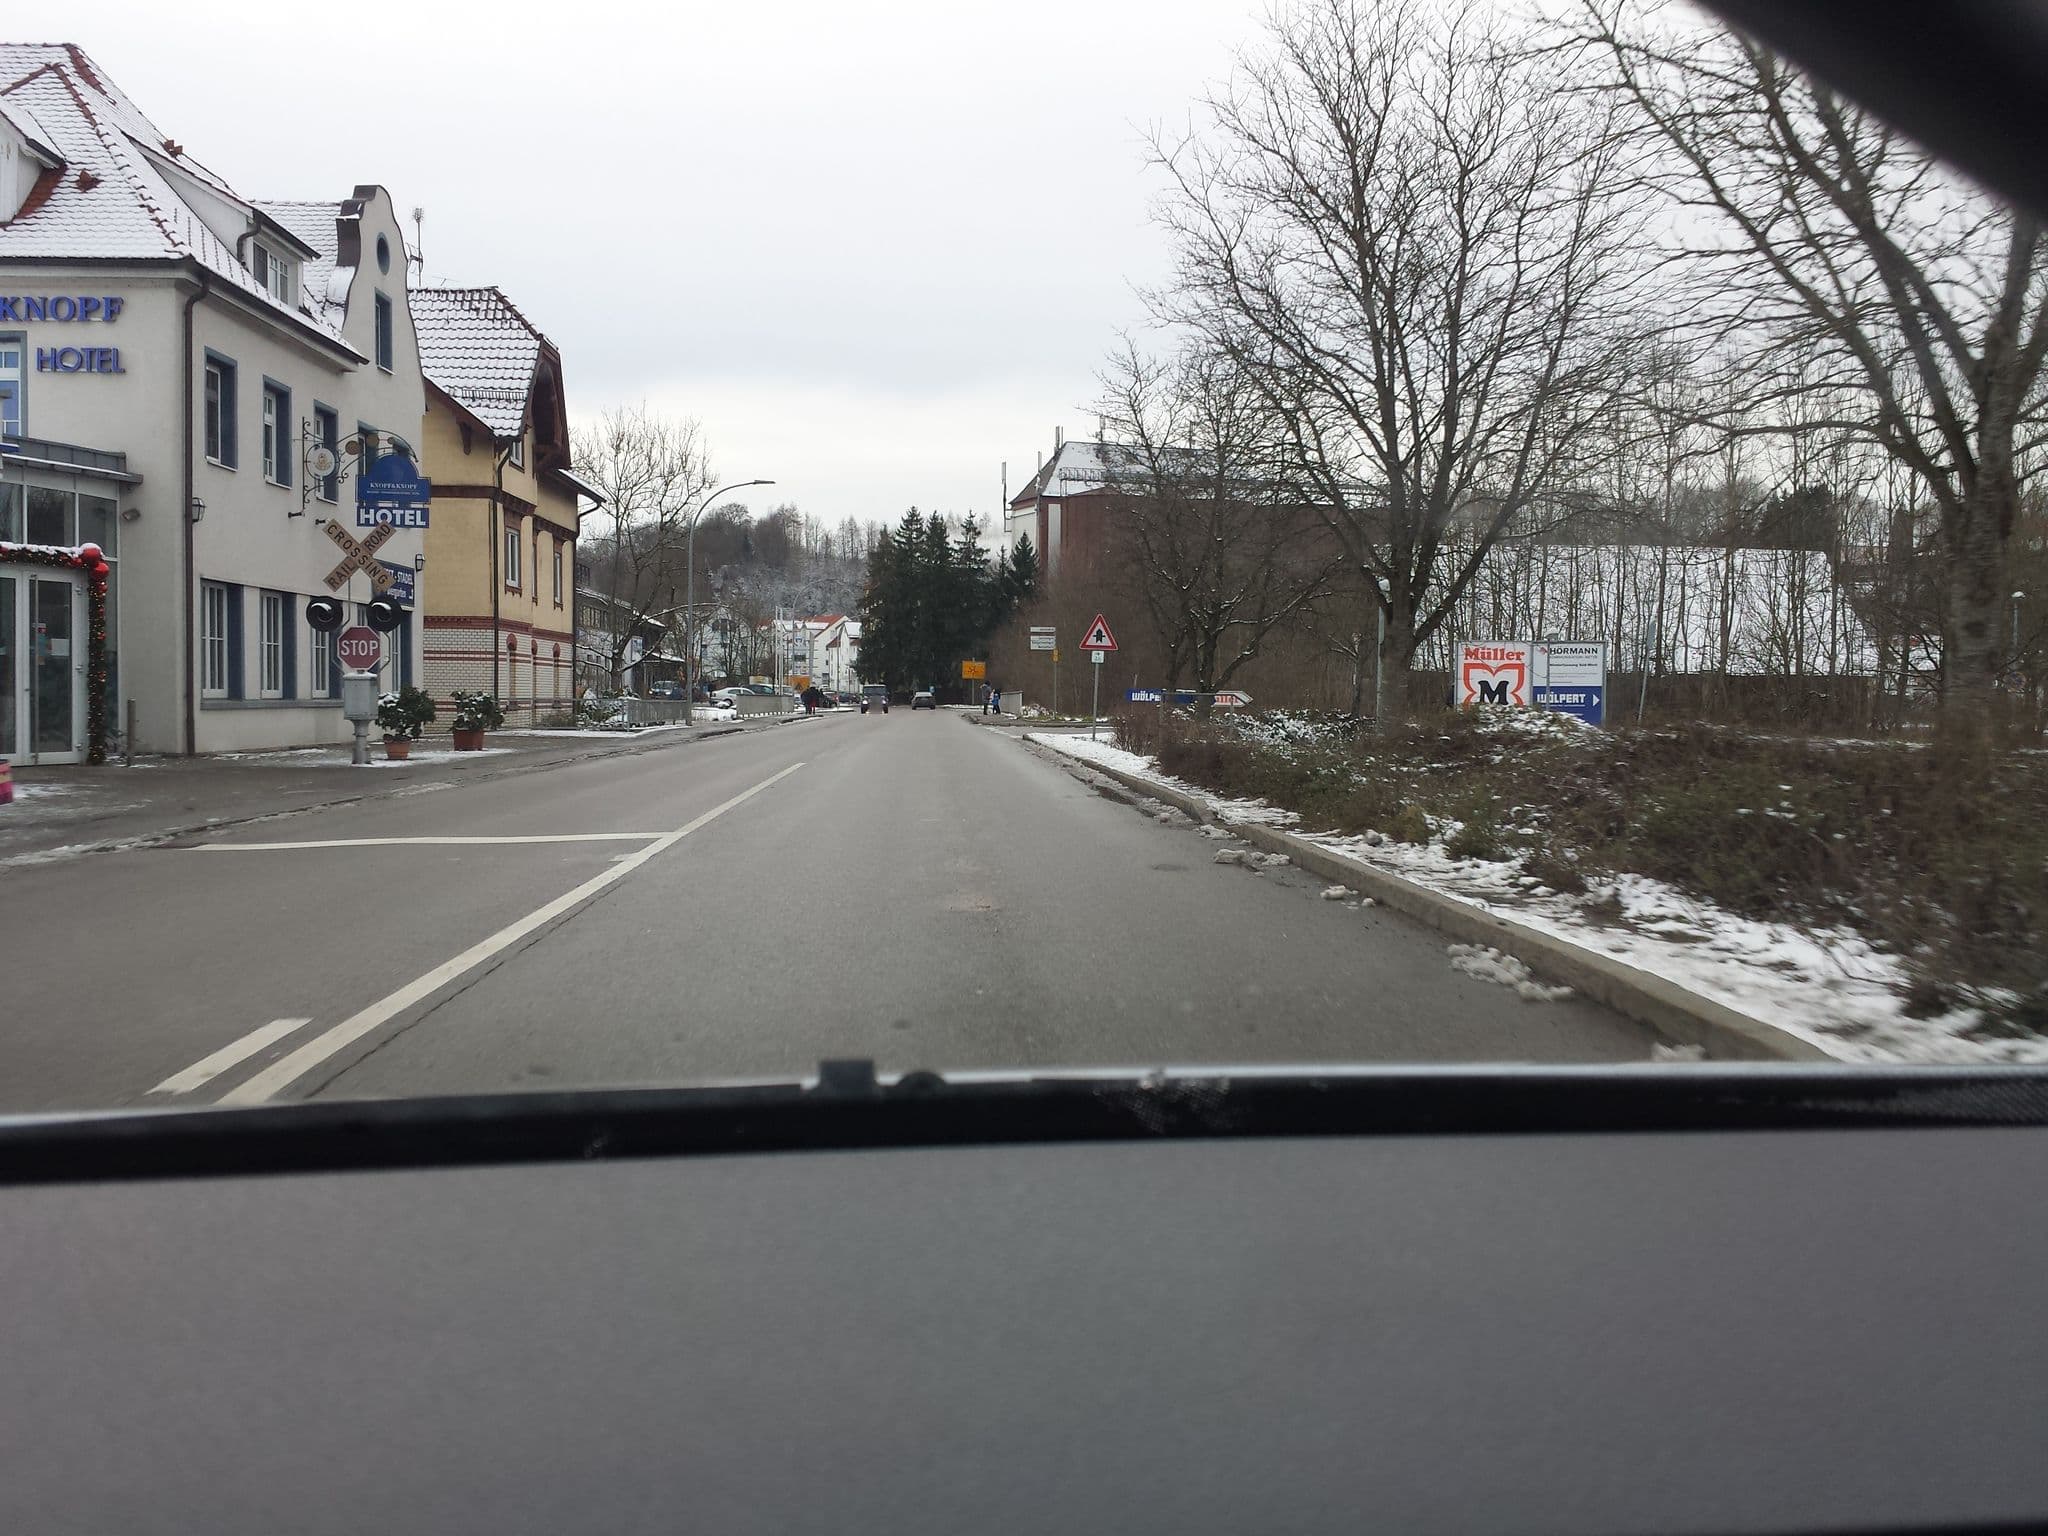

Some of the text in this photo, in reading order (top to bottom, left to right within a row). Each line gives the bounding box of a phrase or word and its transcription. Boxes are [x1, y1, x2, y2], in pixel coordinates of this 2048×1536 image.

[0, 296, 124, 322] KNOPF
[36, 347, 126, 373] HOTEL
[359, 508, 426, 526] HOTEL
[327, 524, 388, 585] CROSSING
[327, 562, 355, 589] RAIL
[364, 524, 391, 551] ROAD
[340, 639, 379, 656] STOP
[1464, 646, 1525, 661] Müller
[1549, 646, 1598, 655] HÖRMANN
